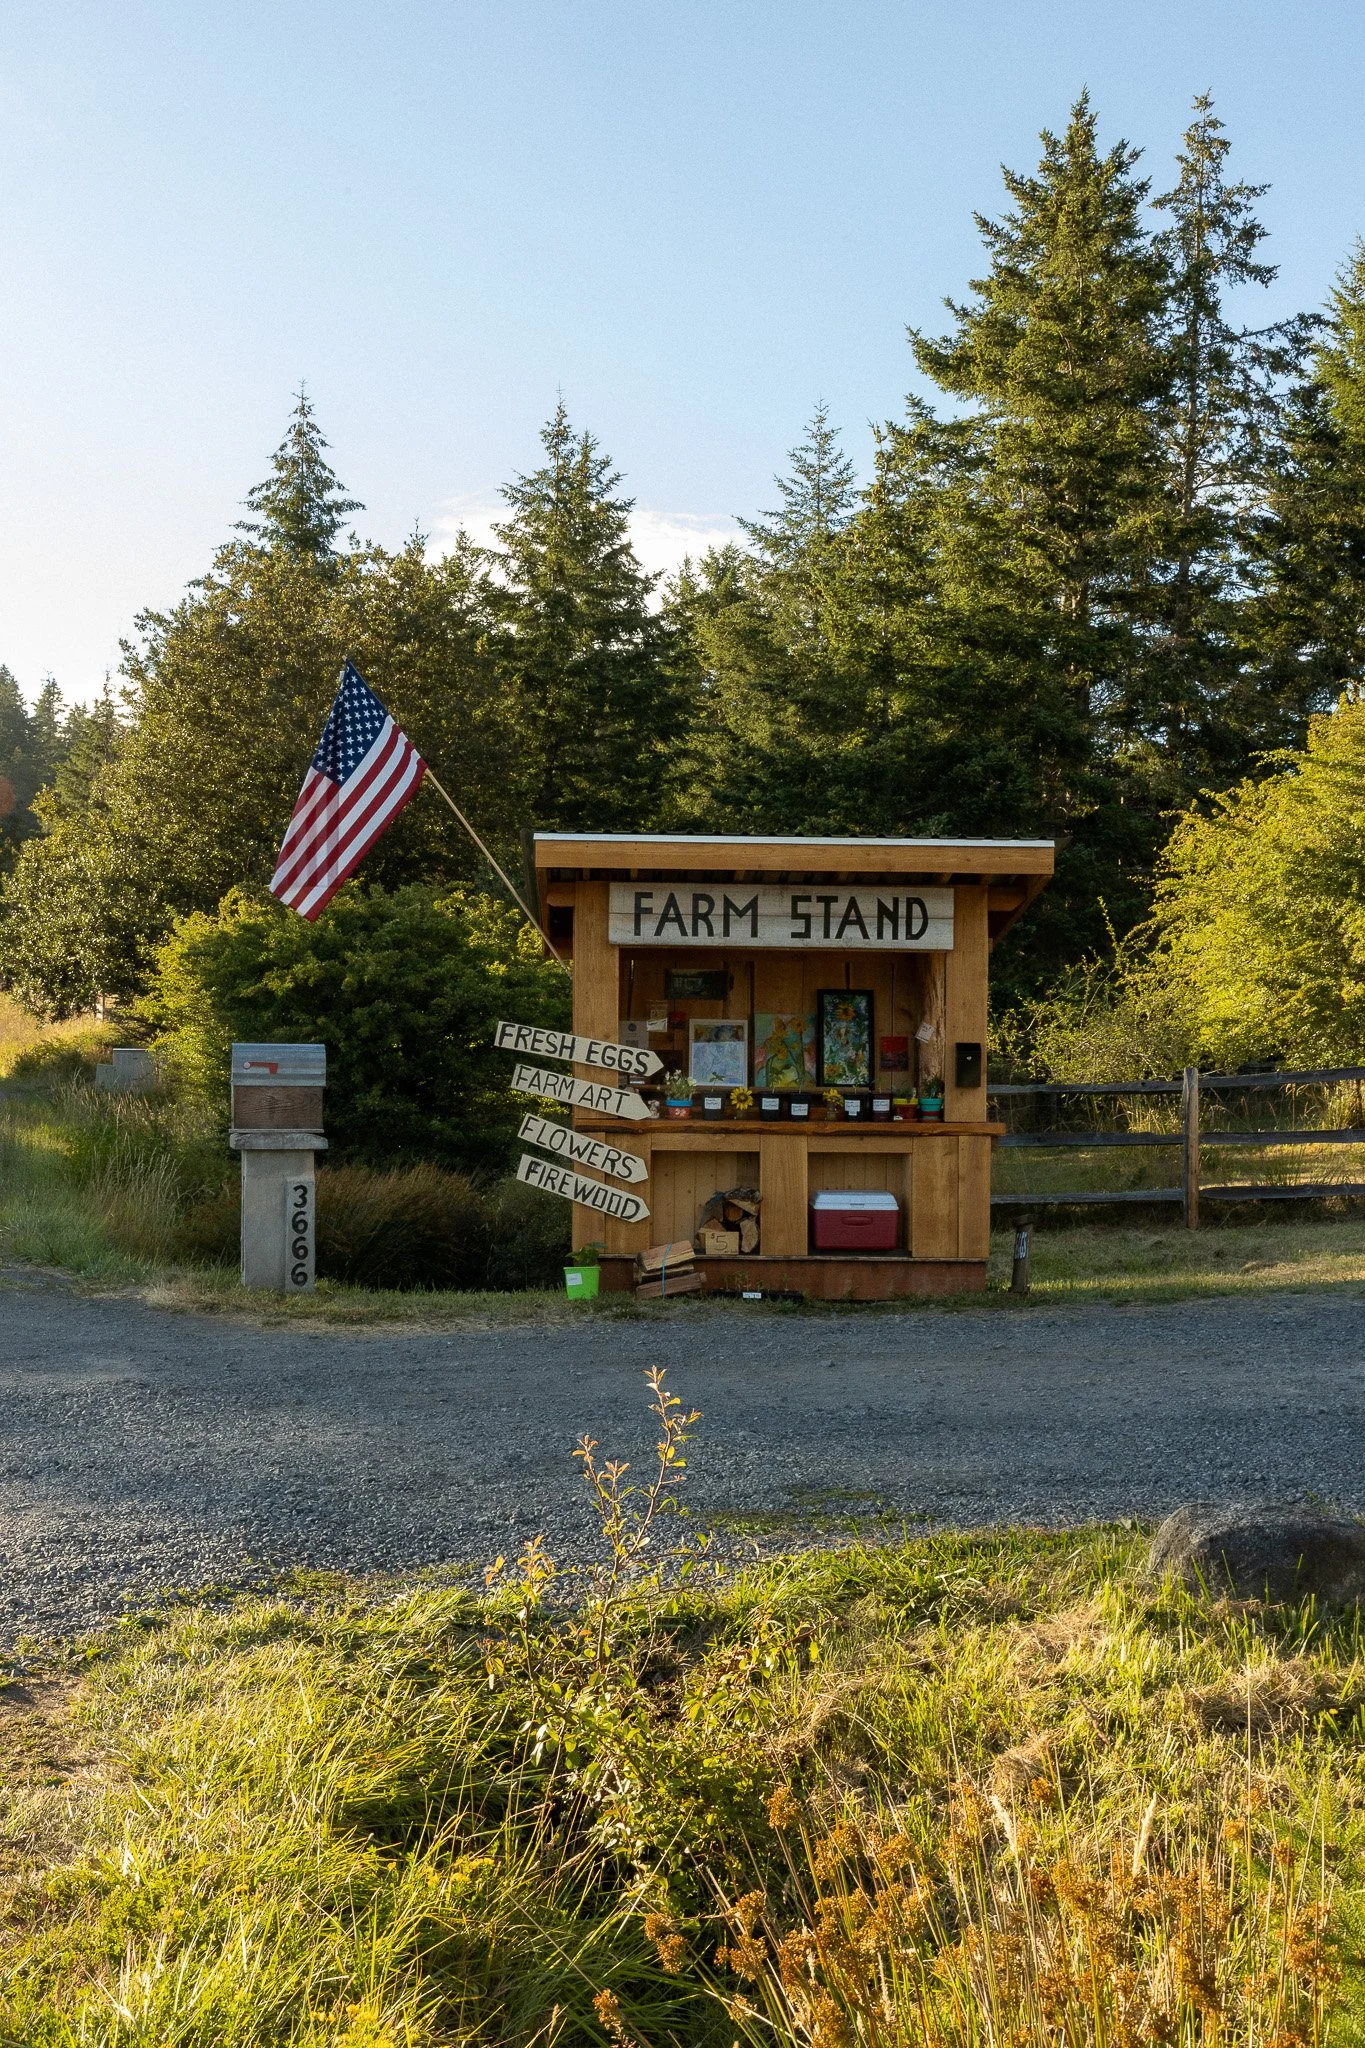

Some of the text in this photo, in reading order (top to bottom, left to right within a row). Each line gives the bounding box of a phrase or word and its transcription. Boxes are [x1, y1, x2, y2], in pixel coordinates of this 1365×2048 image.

[633, 891, 930, 941] FARM STAND
[499, 1023, 650, 1076] FRESH EGGS
[515, 1064, 631, 1114] FARM ART
[519, 1115, 638, 1180] FLOWERS
[524, 1159, 641, 1221] FIREWOOD
[290, 1184, 309, 1288] 3666
